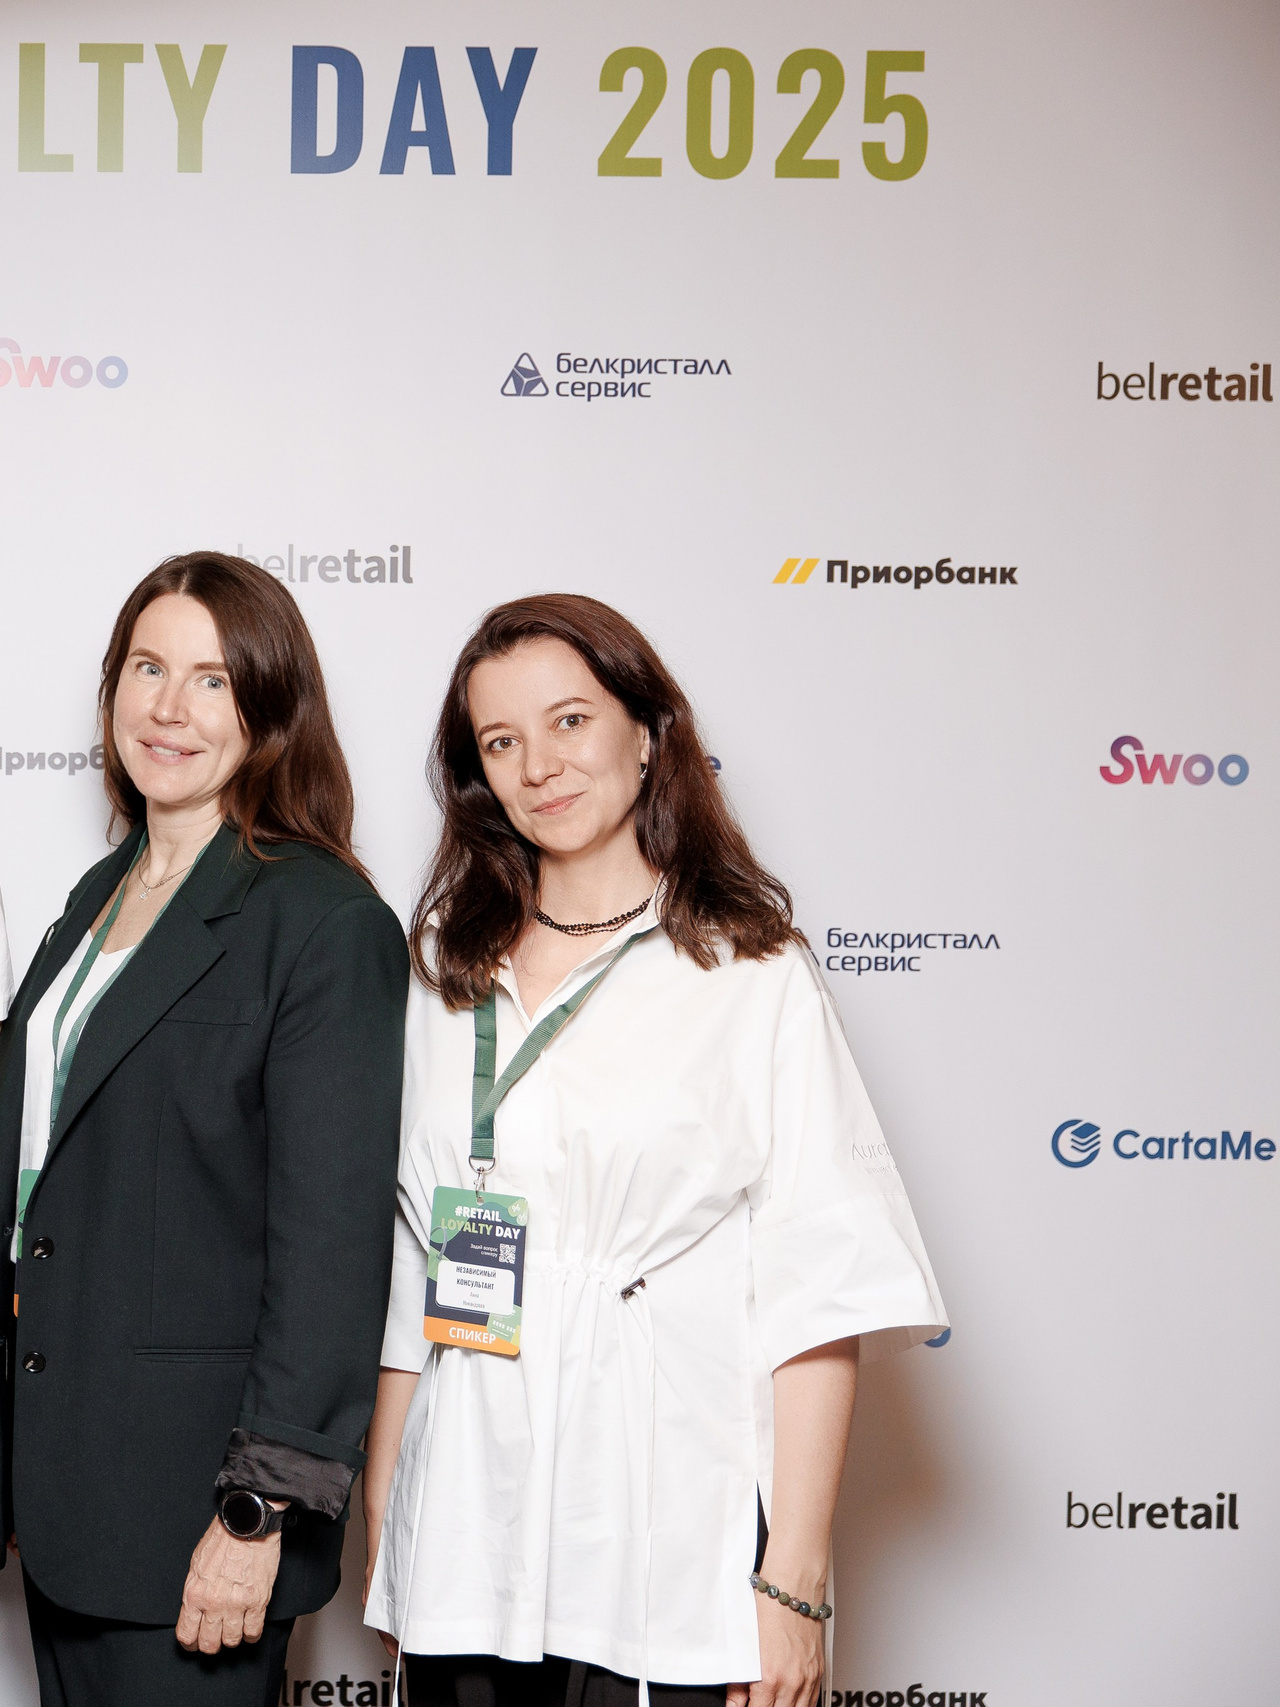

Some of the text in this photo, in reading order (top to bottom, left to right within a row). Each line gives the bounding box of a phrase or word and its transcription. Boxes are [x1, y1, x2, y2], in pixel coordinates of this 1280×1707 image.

[290, 45, 538, 176] DAY
[597, 46, 929, 182] 2025
[556, 352, 732, 376] белкристалл
[556, 379, 652, 402] сервис
[1097, 361, 1274, 403] belretail
[826, 557, 1019, 590] Приорбанк
[1099, 735, 1250, 787] Swoo
[826, 928, 1001, 950] белкристалл
[826, 954, 921, 977] сервис
[1113, 1129, 1277, 1161] CartaMe
[454, 1205, 503, 1223] #RETAIL
[440, 1217, 521, 1240] LOYALTY DAY
[455, 1265, 497, 1278] НЕЗАВИСИМЫЙ
[456, 1278, 495, 1291] КОНСУЛЬТАНТ
[448, 1326, 497, 1345] СПИКЕР
[1066, 1490, 1240, 1531] belretail
